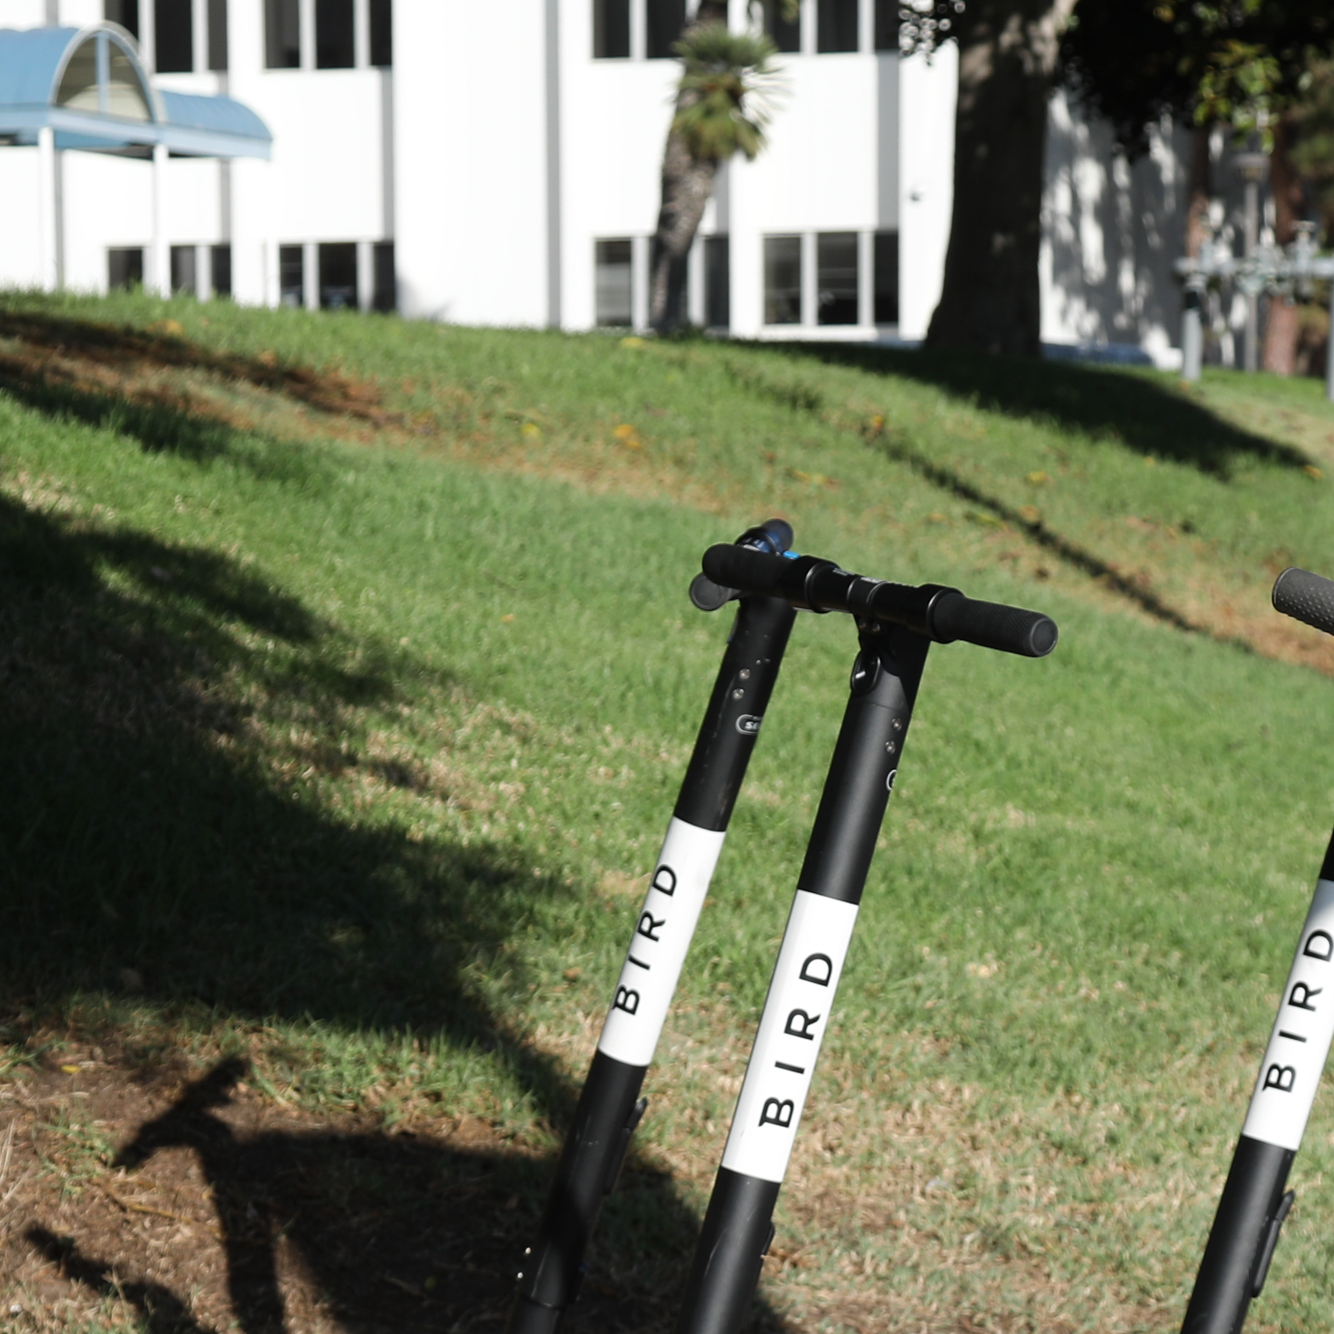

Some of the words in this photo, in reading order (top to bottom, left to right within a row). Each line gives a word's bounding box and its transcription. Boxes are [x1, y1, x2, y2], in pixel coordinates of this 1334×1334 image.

[611, 864, 677, 1015] BIRD
[1262, 930, 1333, 1092] BIRD
[758, 953, 833, 1128] BIRD
